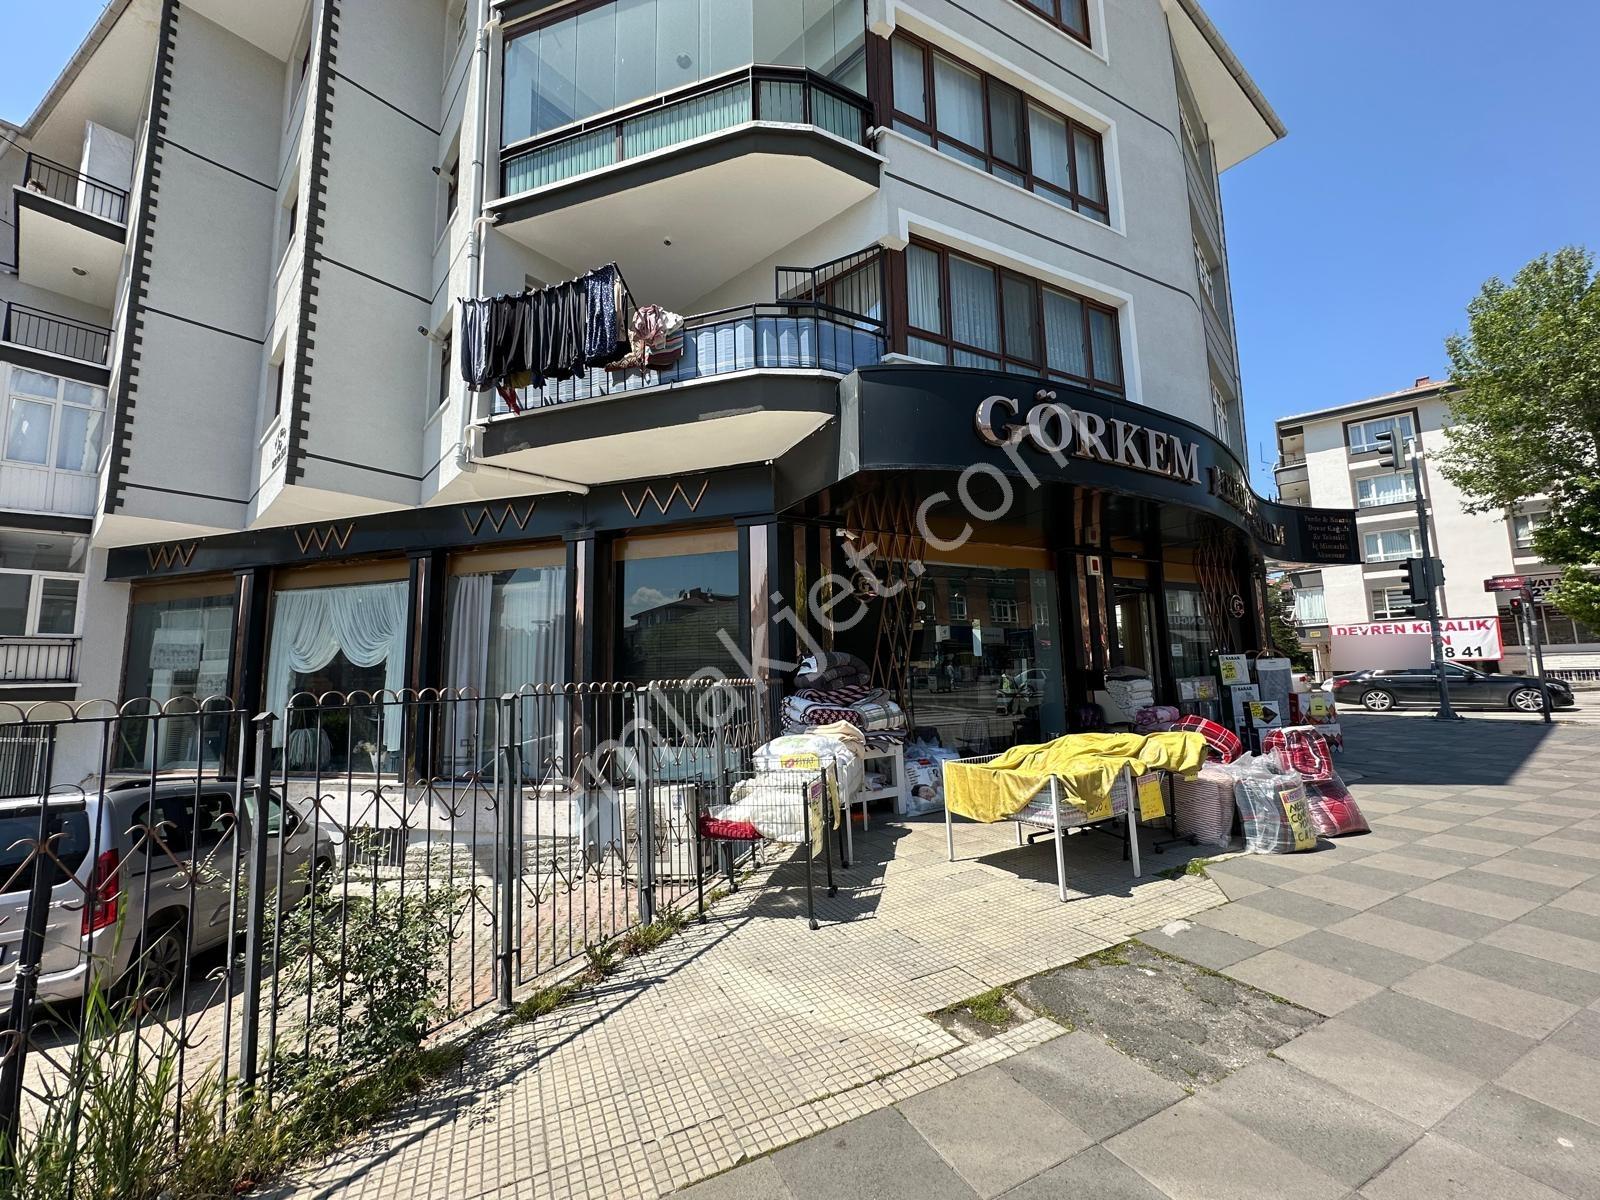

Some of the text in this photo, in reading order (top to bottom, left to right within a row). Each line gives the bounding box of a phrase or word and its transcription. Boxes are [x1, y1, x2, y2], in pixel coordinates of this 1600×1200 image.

[973, 389, 1202, 485] GÖRKEM
[1336, 619, 1491, 636] DEVREN KiALIK
[1461, 646, 1483, 658] 41
